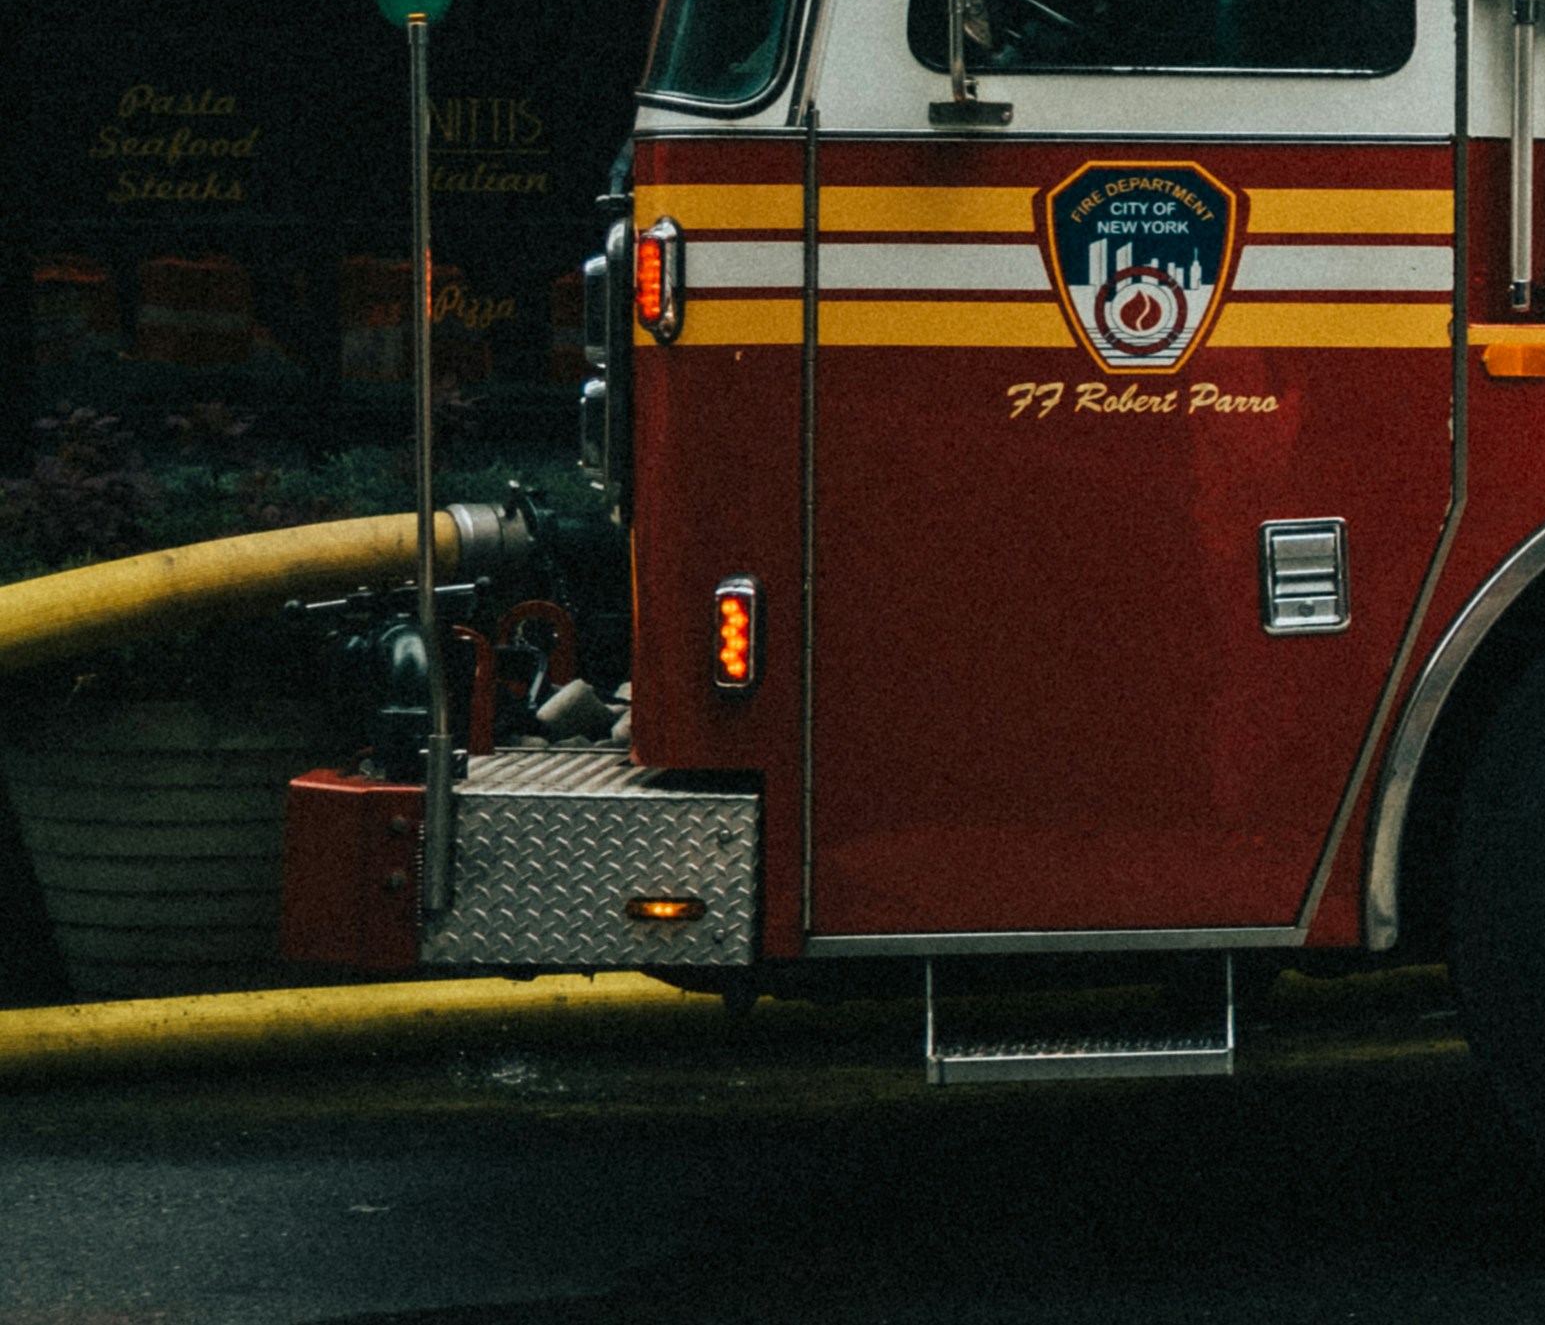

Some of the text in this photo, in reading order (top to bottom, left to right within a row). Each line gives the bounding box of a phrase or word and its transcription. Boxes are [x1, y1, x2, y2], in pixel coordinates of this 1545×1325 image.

[119, 83, 237, 118] Pasta
[90, 127, 261, 162] Seafood
[108, 171, 244, 204] Steaks
[433, 162, 549, 194] talian
[1071, 177, 1215, 224] FIRE DEPARTMENT
[1110, 202, 1177, 216] CITY OF
[1097, 221, 1189, 234] NEW YORK
[432, 283, 517, 330] Pizza
[1075, 381, 1178, 415] Robert
[1188, 381, 1280, 415] Parro
